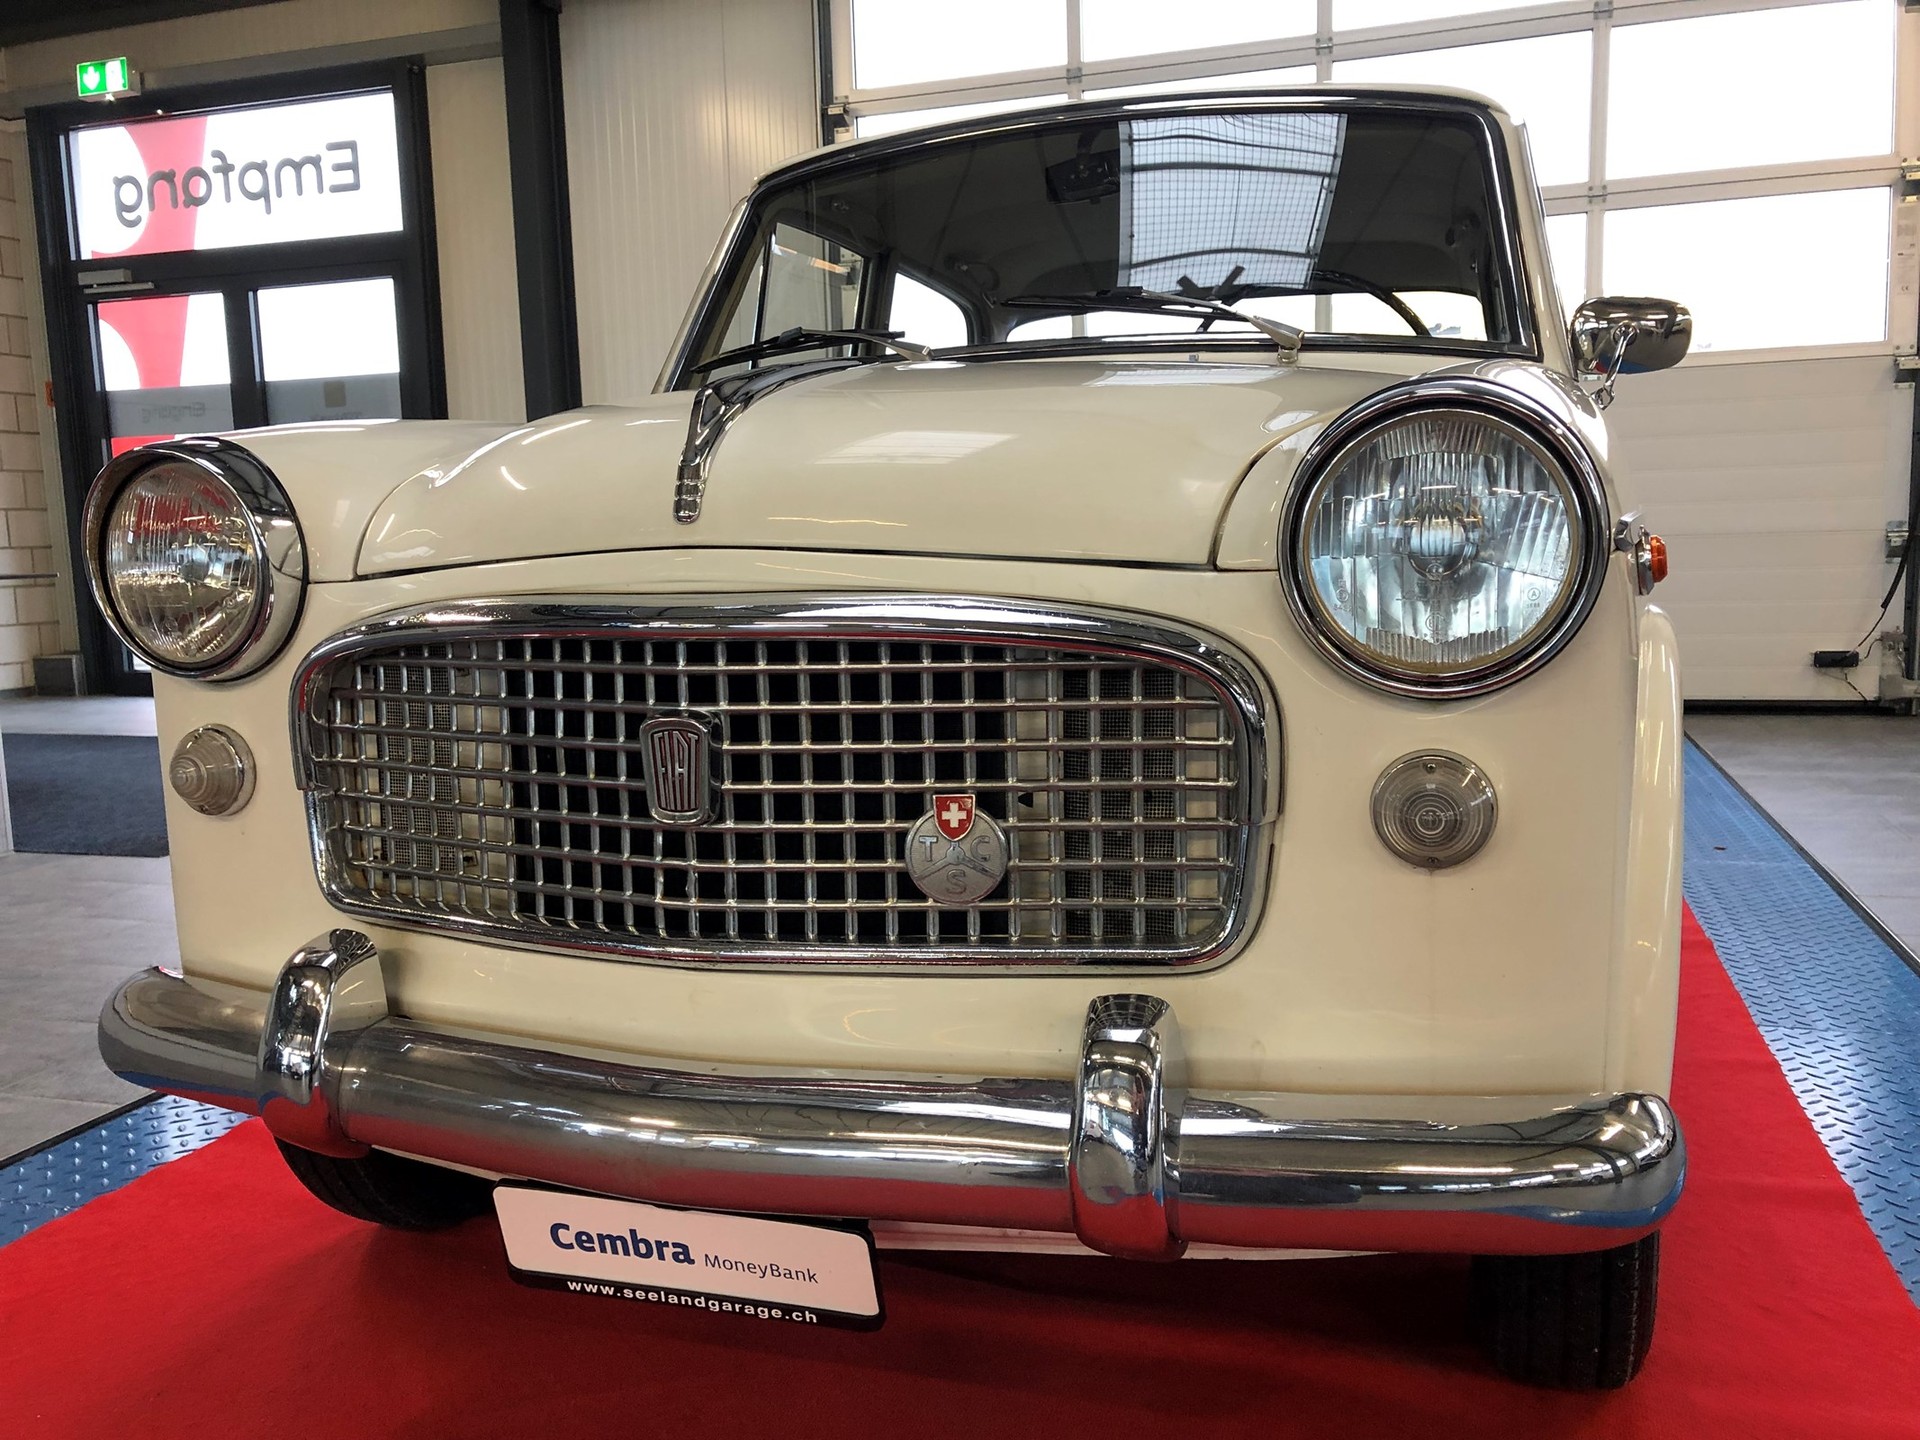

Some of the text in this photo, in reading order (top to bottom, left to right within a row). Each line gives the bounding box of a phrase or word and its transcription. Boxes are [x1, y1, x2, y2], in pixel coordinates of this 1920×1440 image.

[653, 730, 699, 811] FIAT
[549, 1222, 819, 1285] Cembra MoneyBank
[567, 1279, 818, 1324] www.seelandgarage.ch
